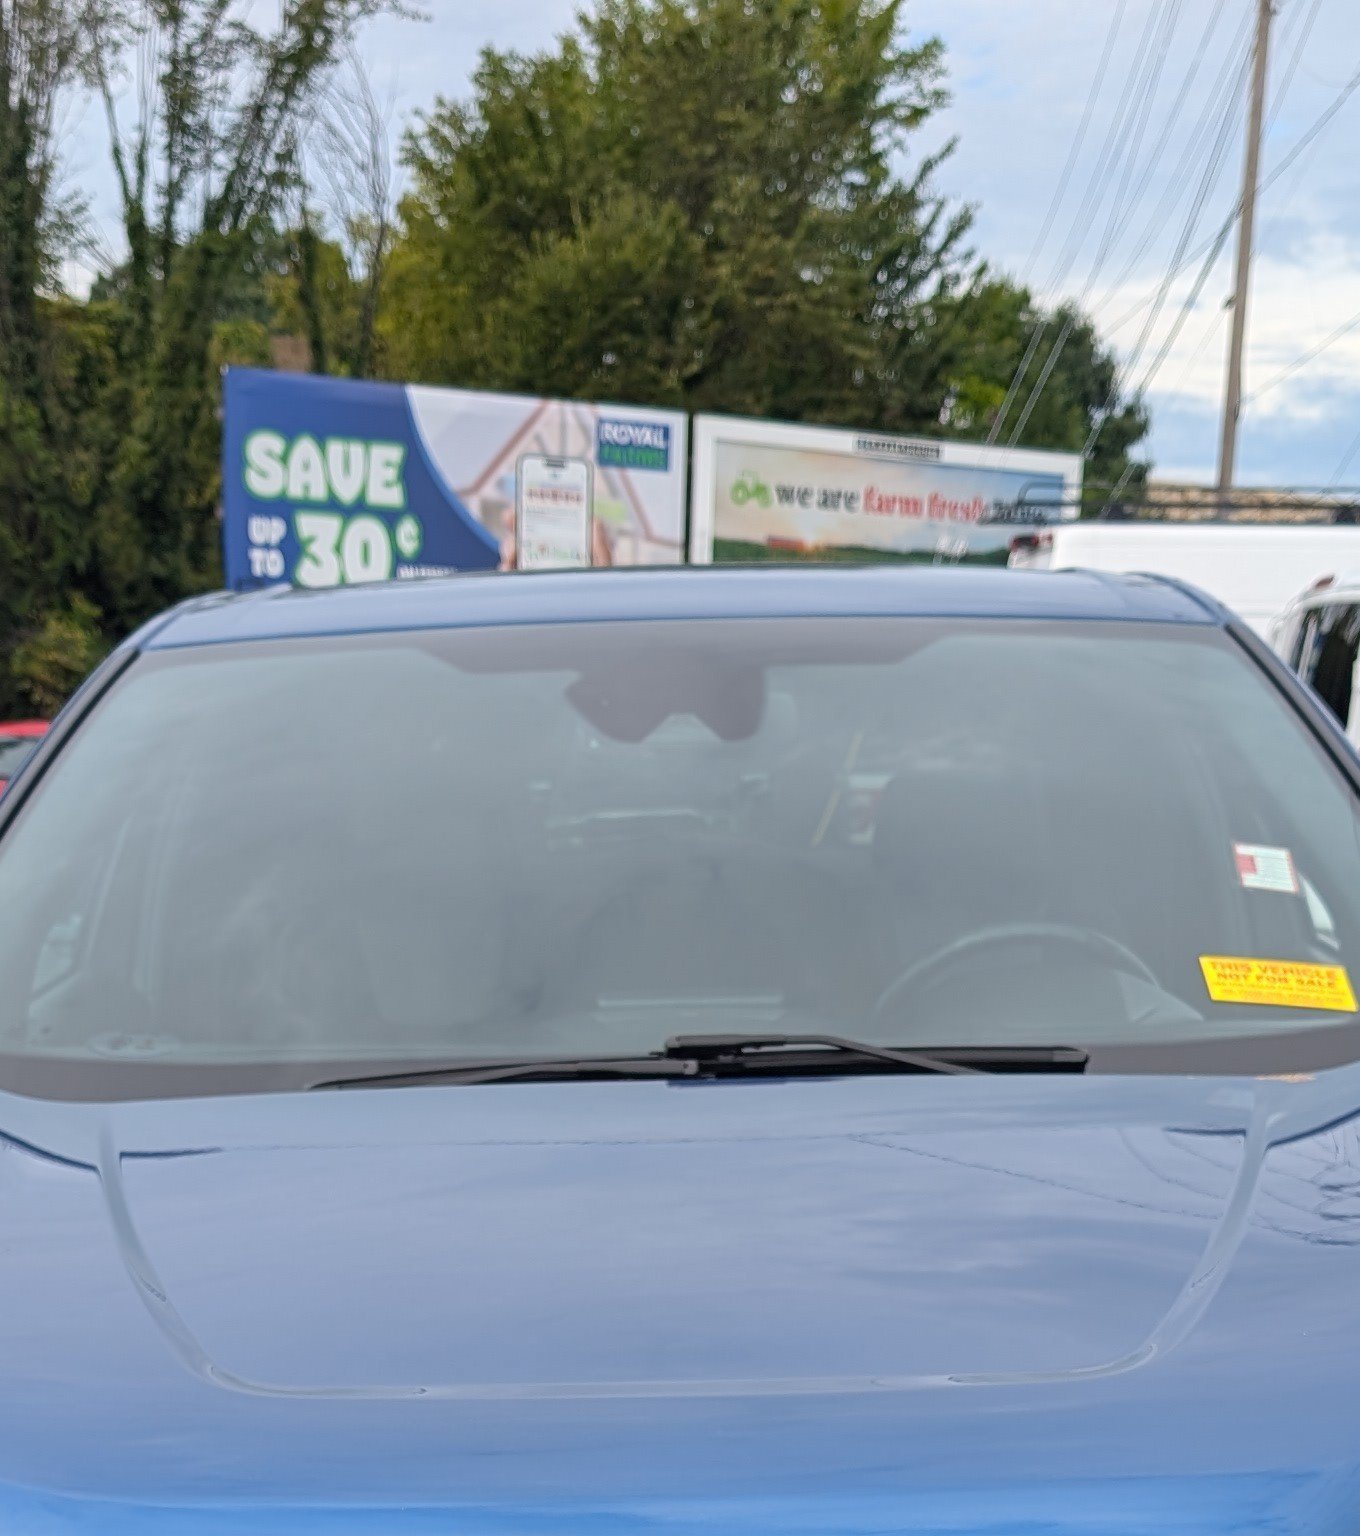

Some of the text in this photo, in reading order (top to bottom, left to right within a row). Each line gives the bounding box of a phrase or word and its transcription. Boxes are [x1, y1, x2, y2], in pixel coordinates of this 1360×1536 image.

[601, 421, 665, 449] ROYAL
[244, 429, 408, 508] SAVE
[775, 484, 814, 505] we
[815, 488, 859, 513] are
[862, 484, 923, 518] farm
[247, 514, 288, 546] UP
[247, 547, 286, 579] TO
[1211, 961, 1337, 980] THIS VEHICLE
[1217, 973, 1337, 988] NOT FOR SALE
